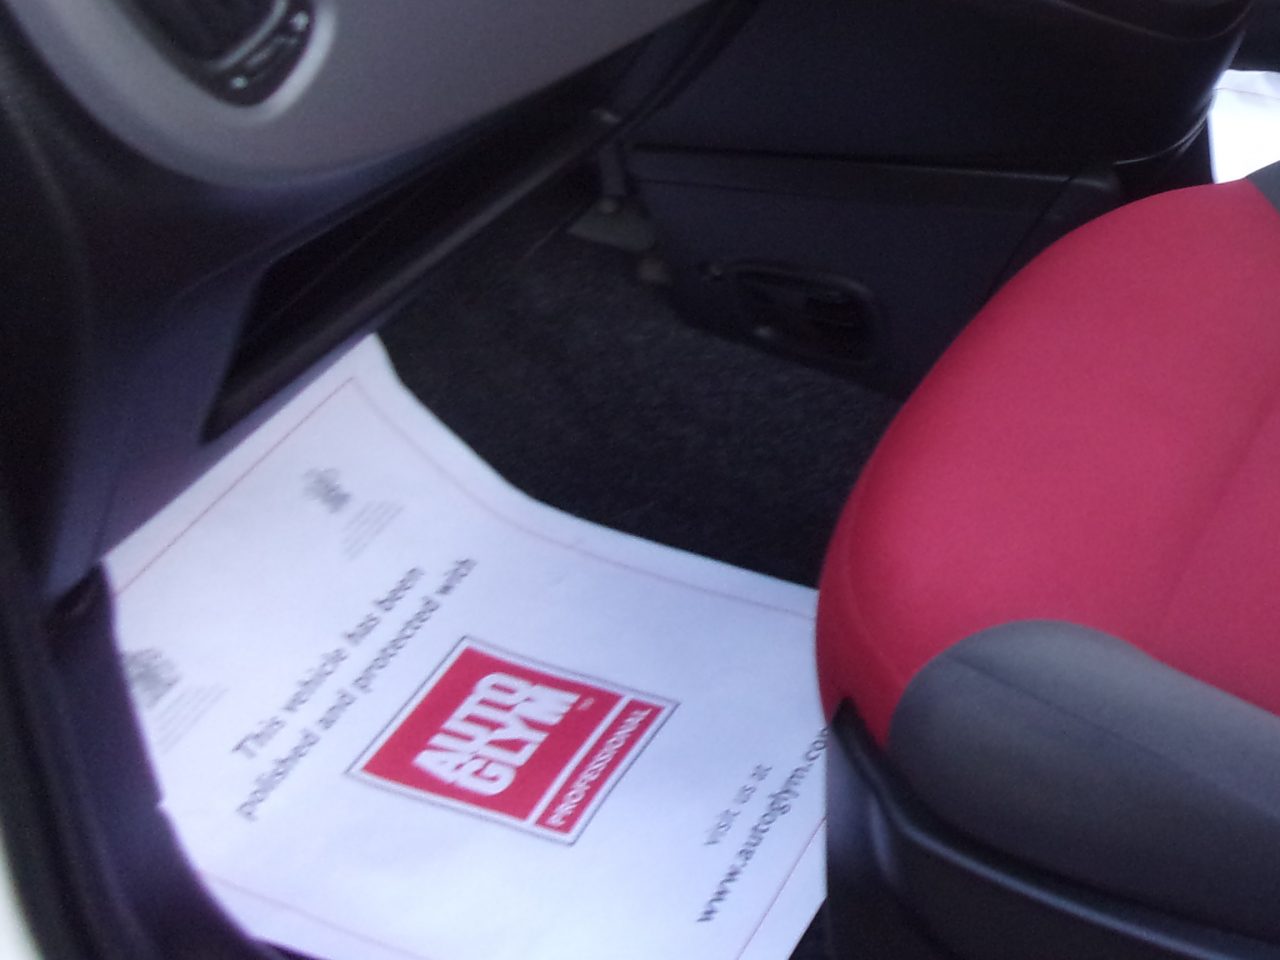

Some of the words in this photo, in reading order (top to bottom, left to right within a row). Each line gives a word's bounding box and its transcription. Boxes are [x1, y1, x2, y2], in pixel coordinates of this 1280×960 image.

[371, 566, 426, 613] been
[316, 688, 358, 731] and
[410, 671, 535, 786] AUTO
[450, 683, 582, 797] GLYM
[548, 707, 653, 827] PROFESSIONAL
